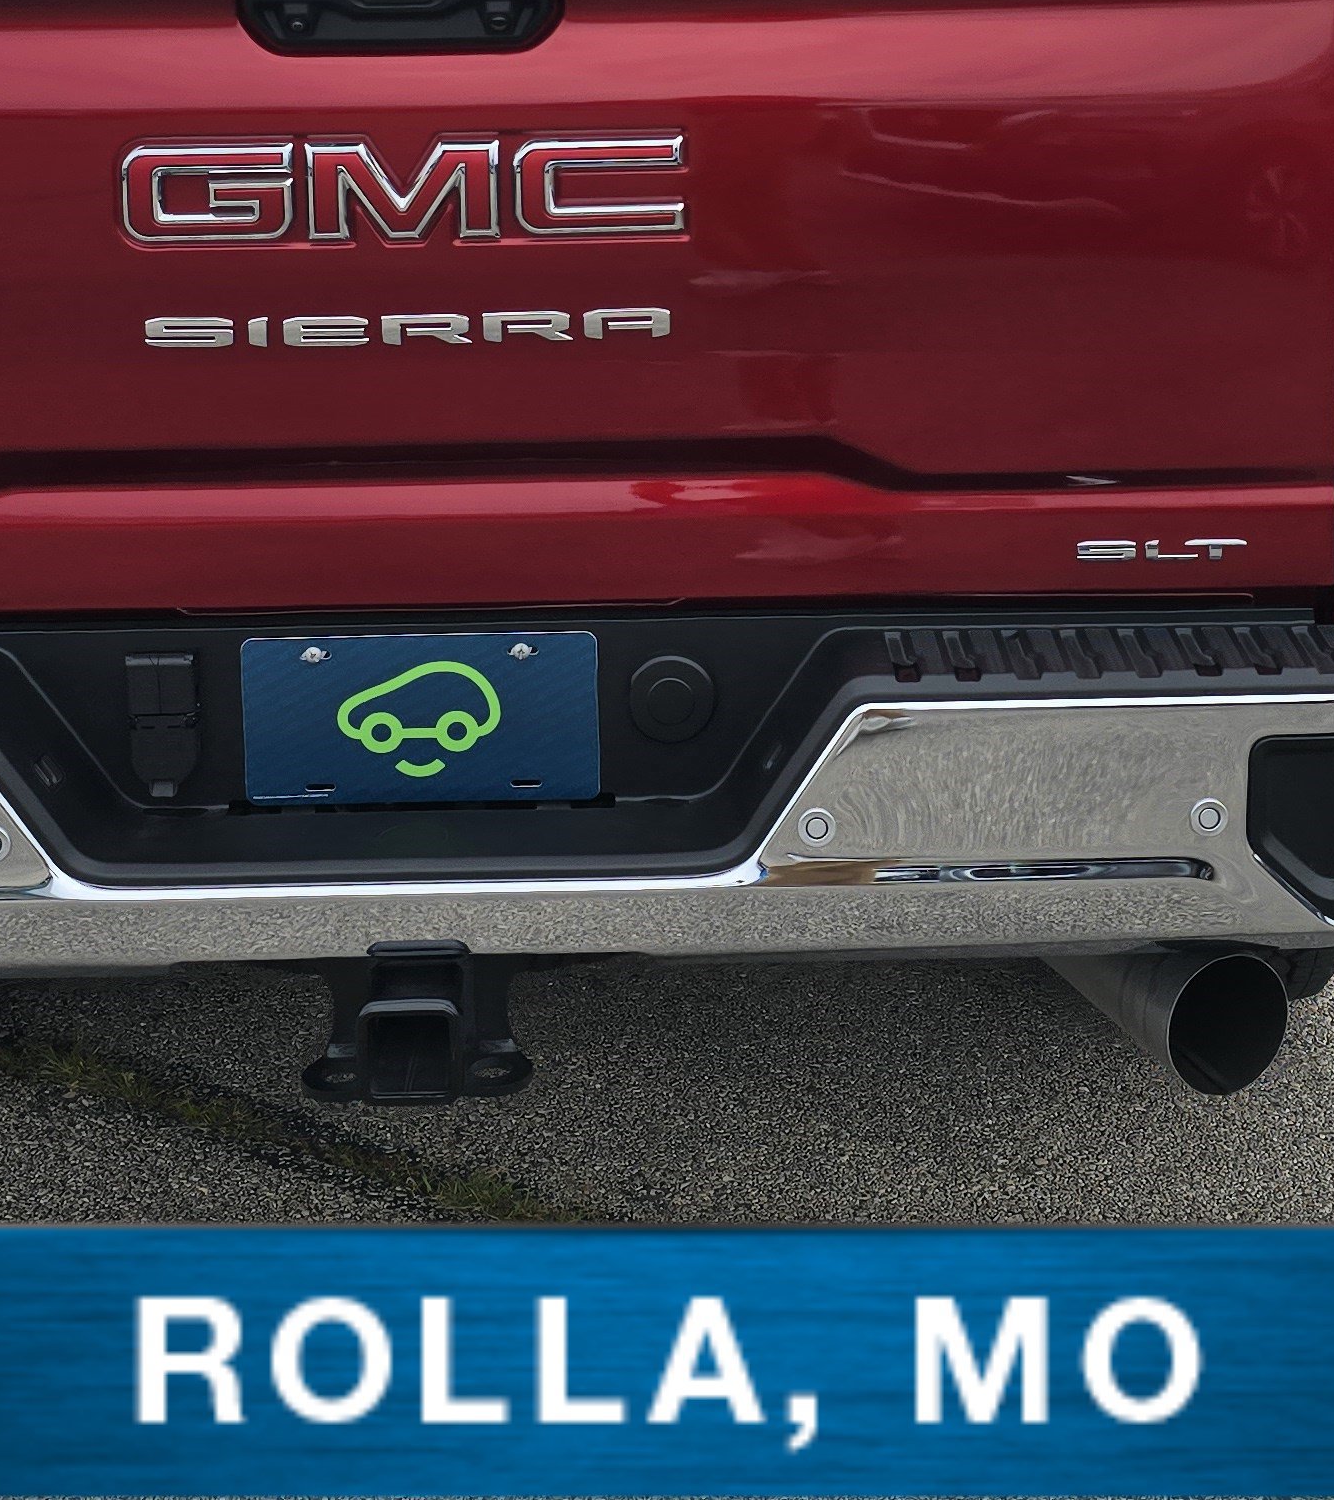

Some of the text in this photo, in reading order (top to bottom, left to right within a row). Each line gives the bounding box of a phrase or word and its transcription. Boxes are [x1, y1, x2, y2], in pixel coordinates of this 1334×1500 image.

[121, 133, 687, 244] GMC
[144, 306, 671, 348] SIERRA
[1076, 537, 1248, 560] SLT
